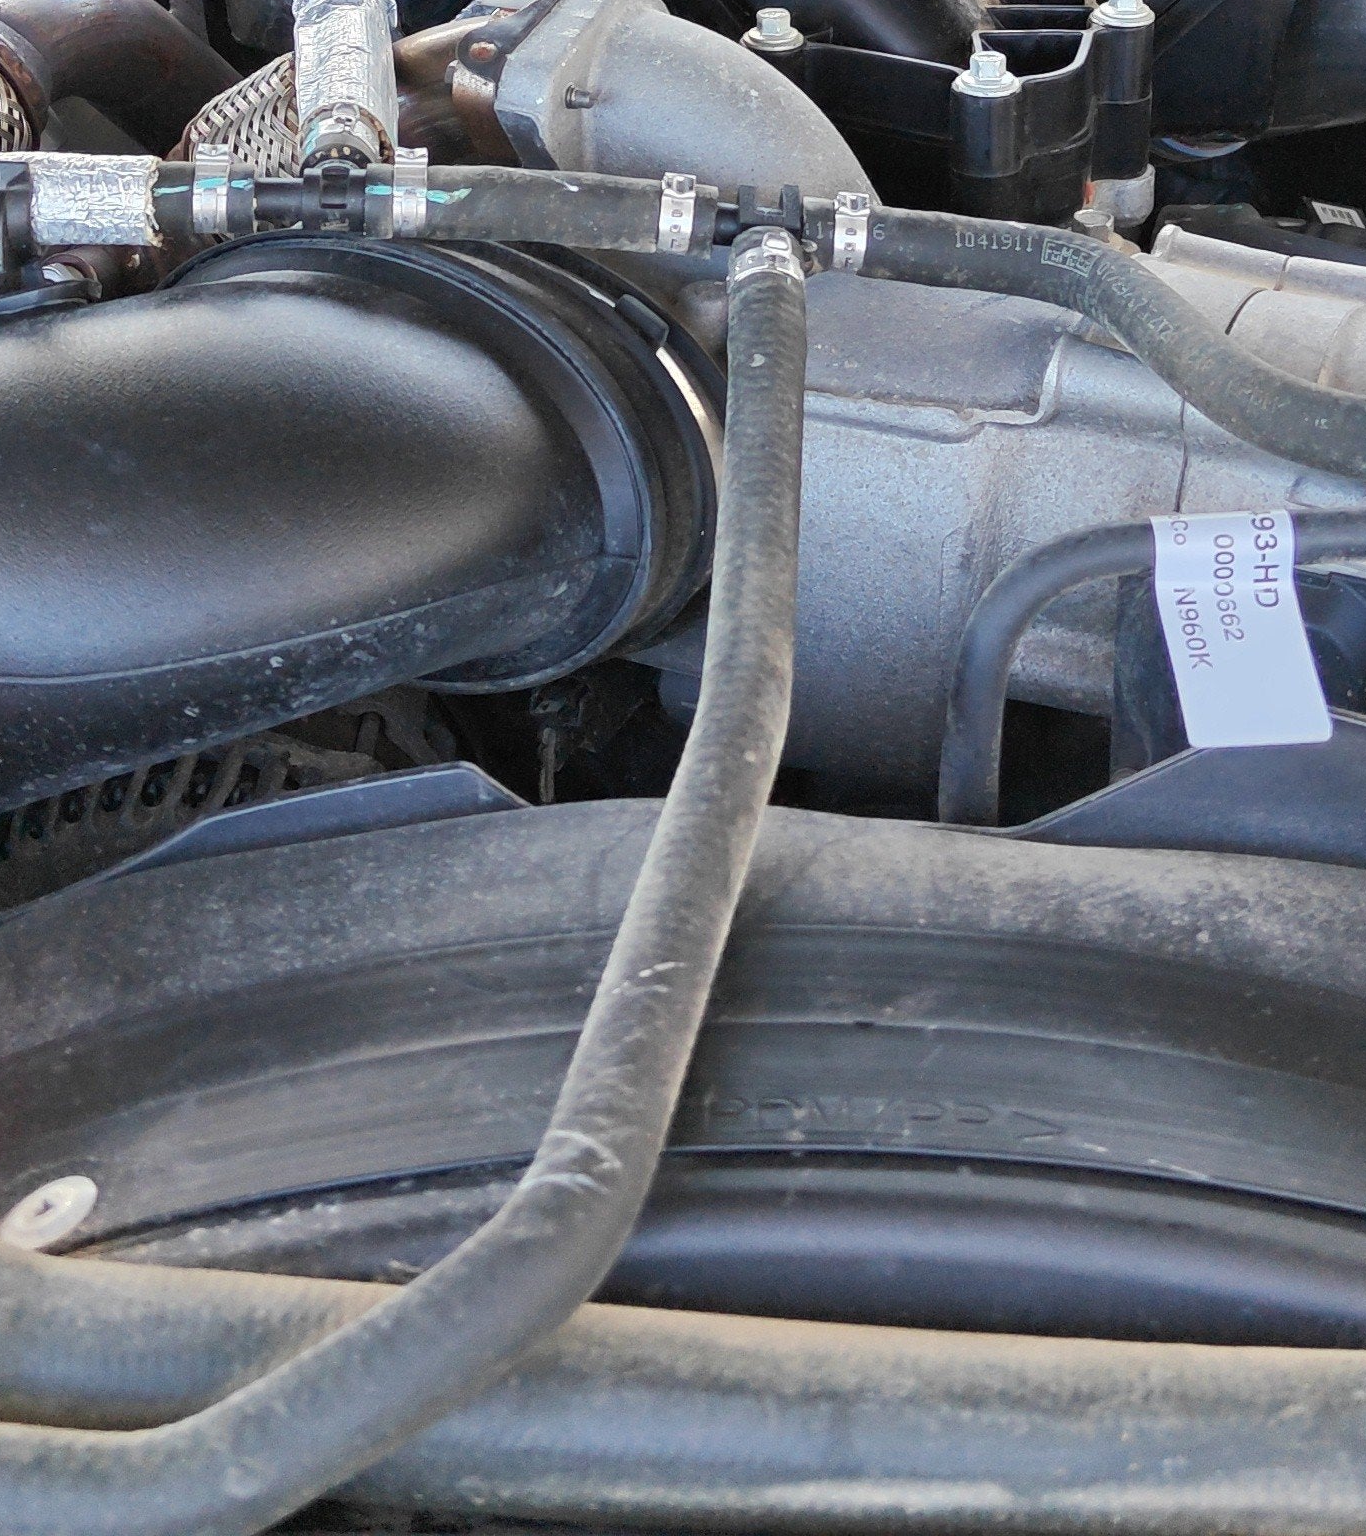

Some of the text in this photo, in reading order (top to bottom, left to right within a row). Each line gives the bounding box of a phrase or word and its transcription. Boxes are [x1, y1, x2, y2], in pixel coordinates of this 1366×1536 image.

[954, 229, 1034, 253] 1041911
[1170, 515, 1214, 670] Co N960K
[1212, 533, 1246, 642] 0000662
[1250, 512, 1280, 608] 93-HD
